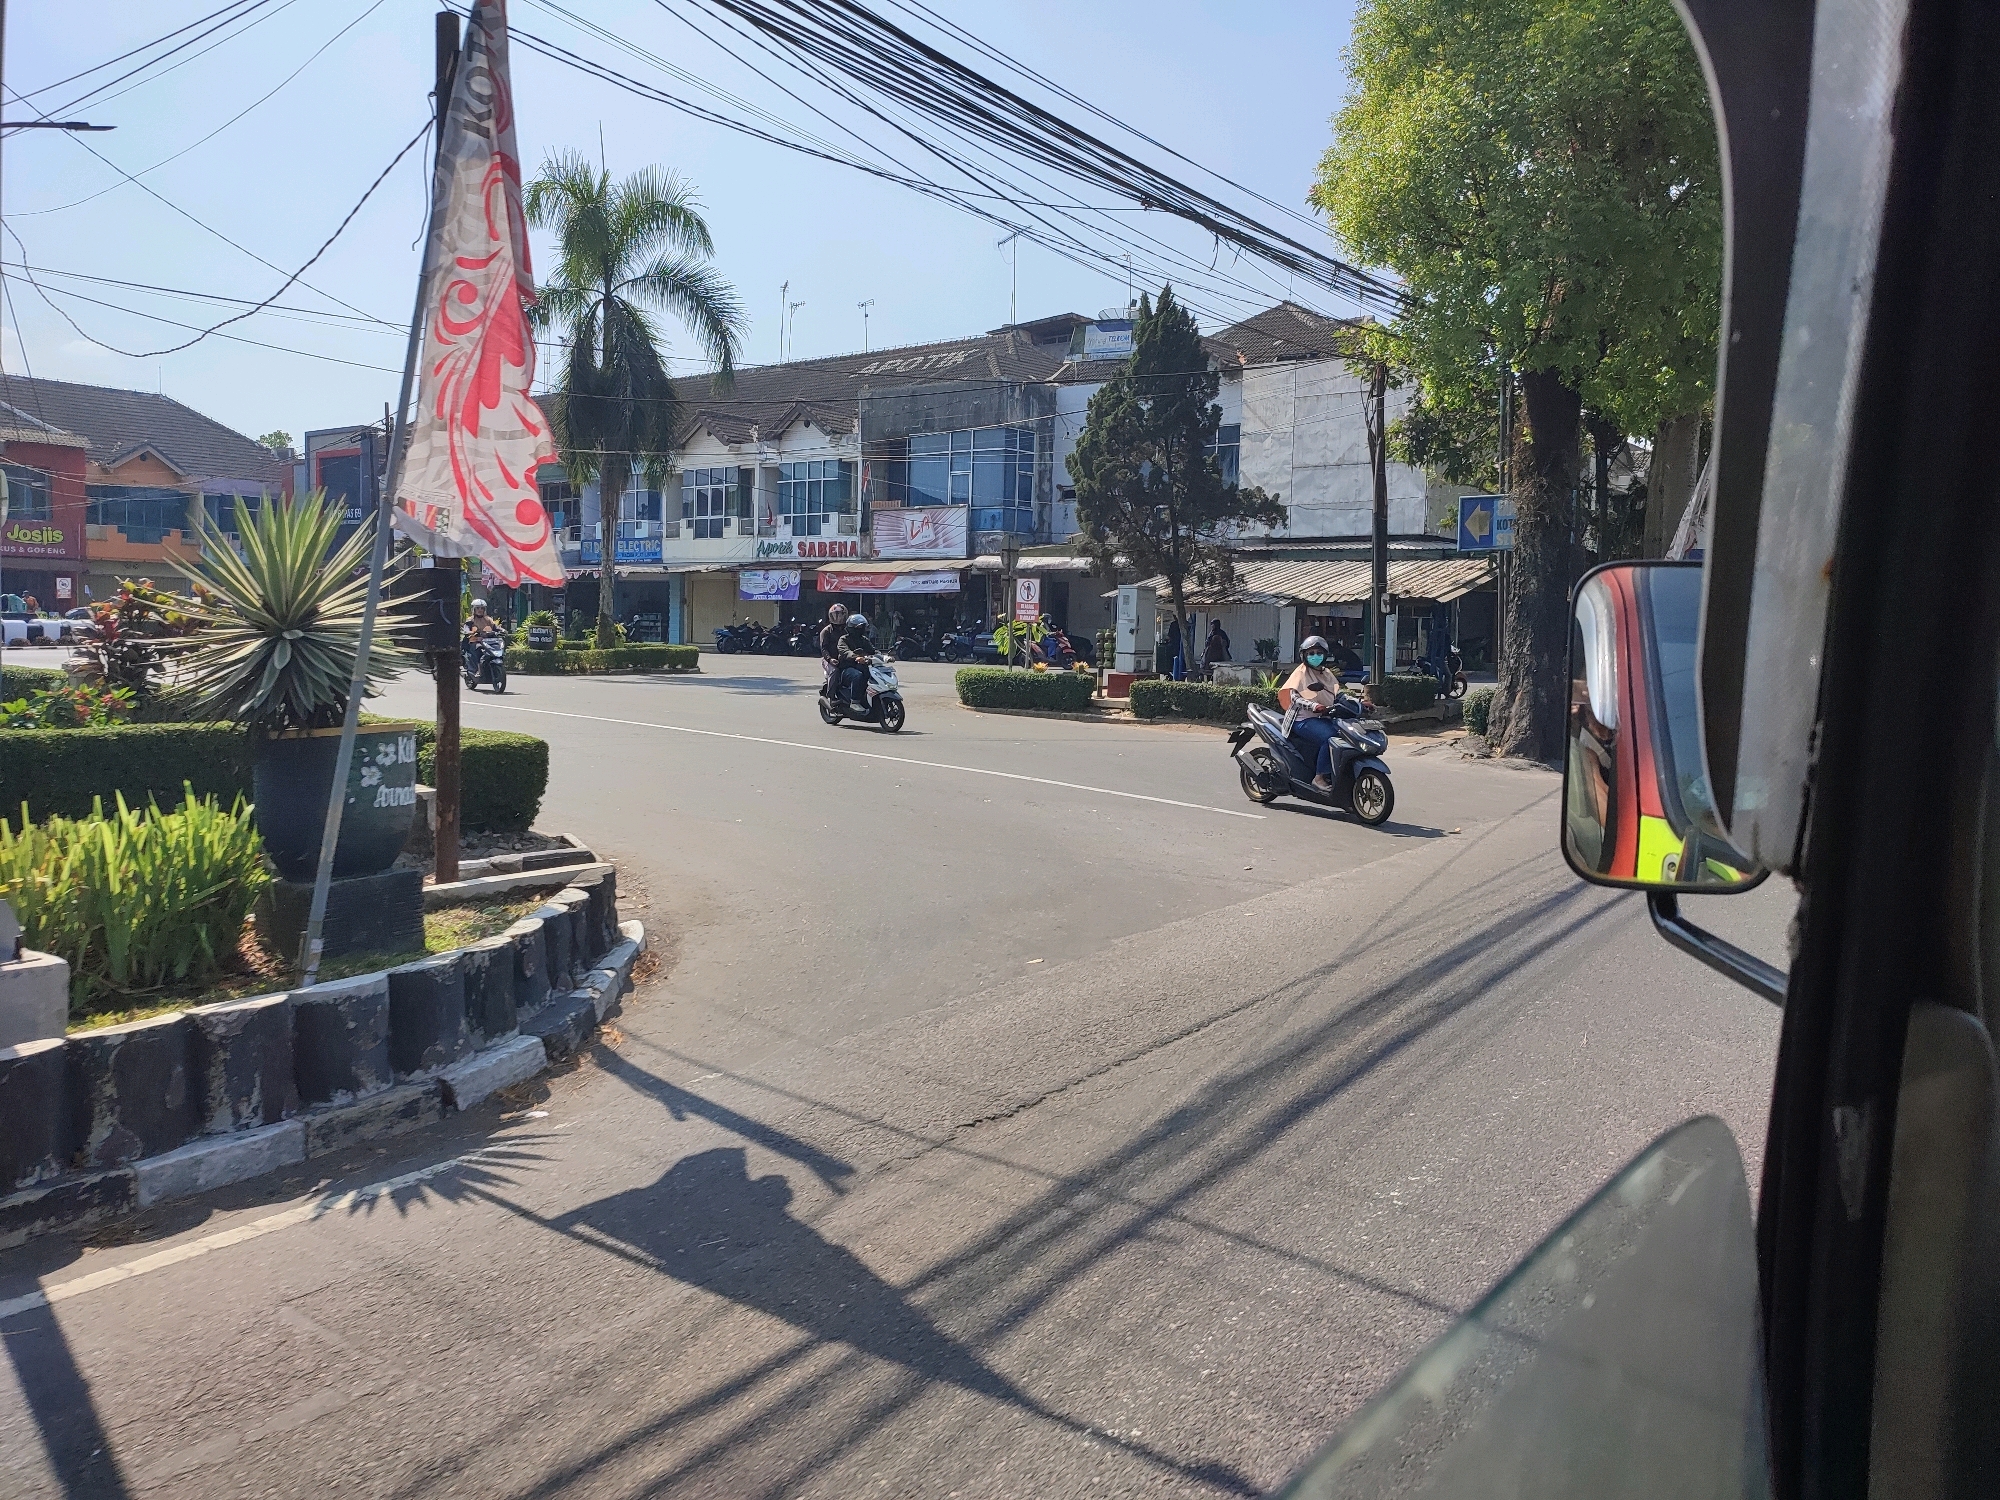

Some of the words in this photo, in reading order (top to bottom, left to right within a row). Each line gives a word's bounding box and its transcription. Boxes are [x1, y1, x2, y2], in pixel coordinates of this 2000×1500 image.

[1496, 518, 1516, 531] KOT
[617, 540, 661, 554] ELECTRIC
[797, 540, 858, 558] SABENA
